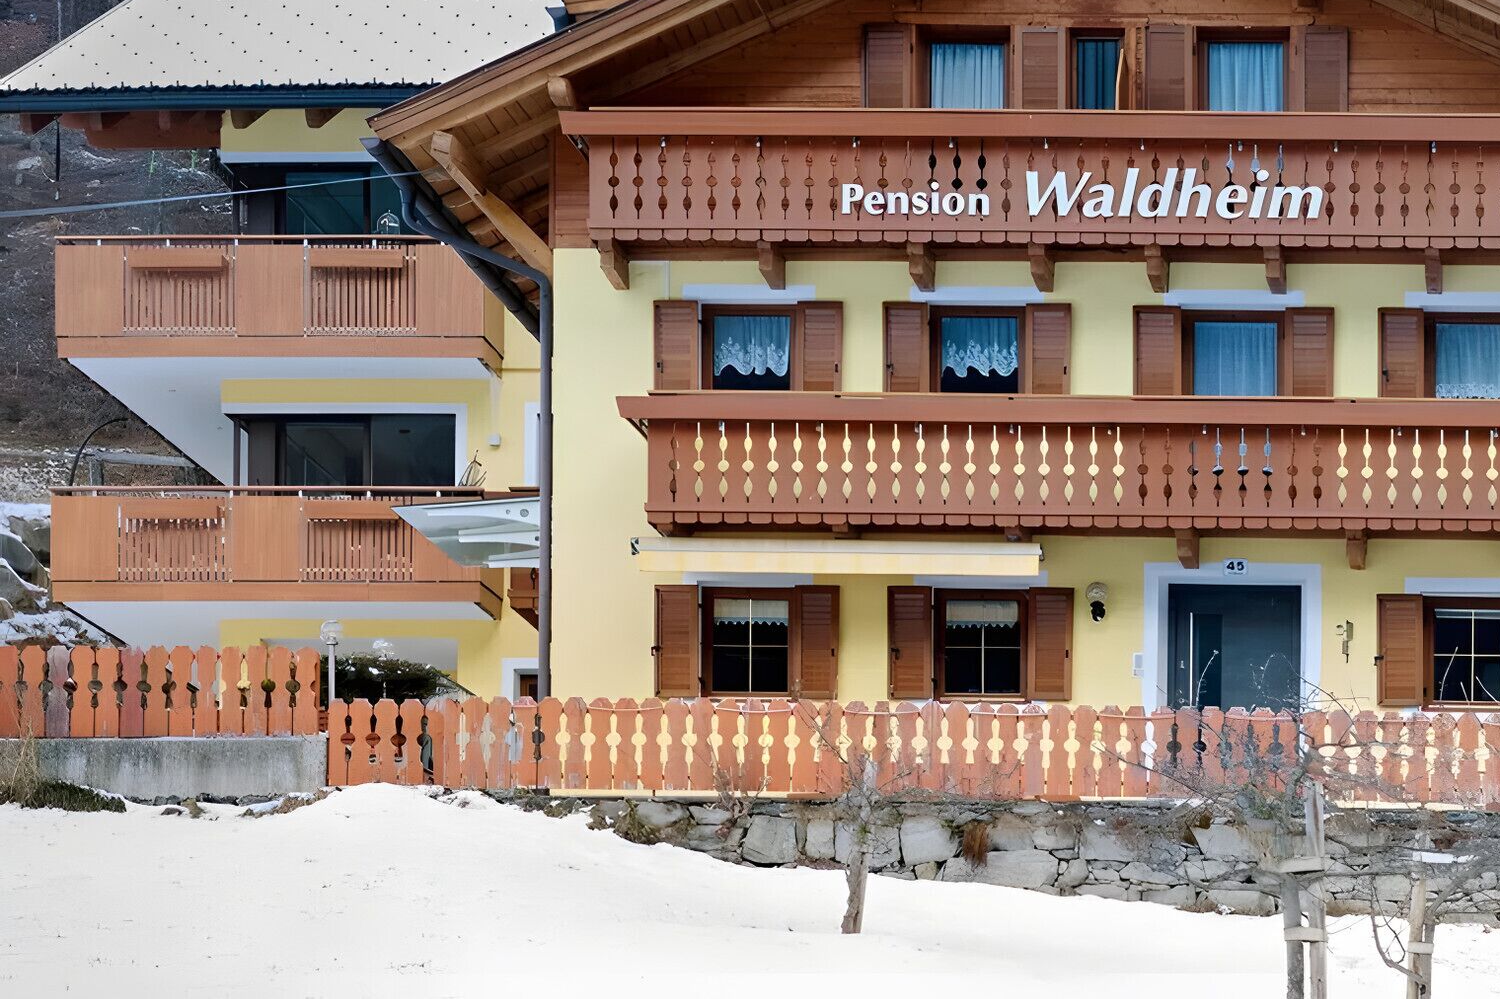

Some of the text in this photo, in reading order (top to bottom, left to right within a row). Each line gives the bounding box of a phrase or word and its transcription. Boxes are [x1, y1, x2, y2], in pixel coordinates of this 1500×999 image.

[841, 168, 1324, 220] Pension Waldheim
[1226, 560, 1245, 572] 45
